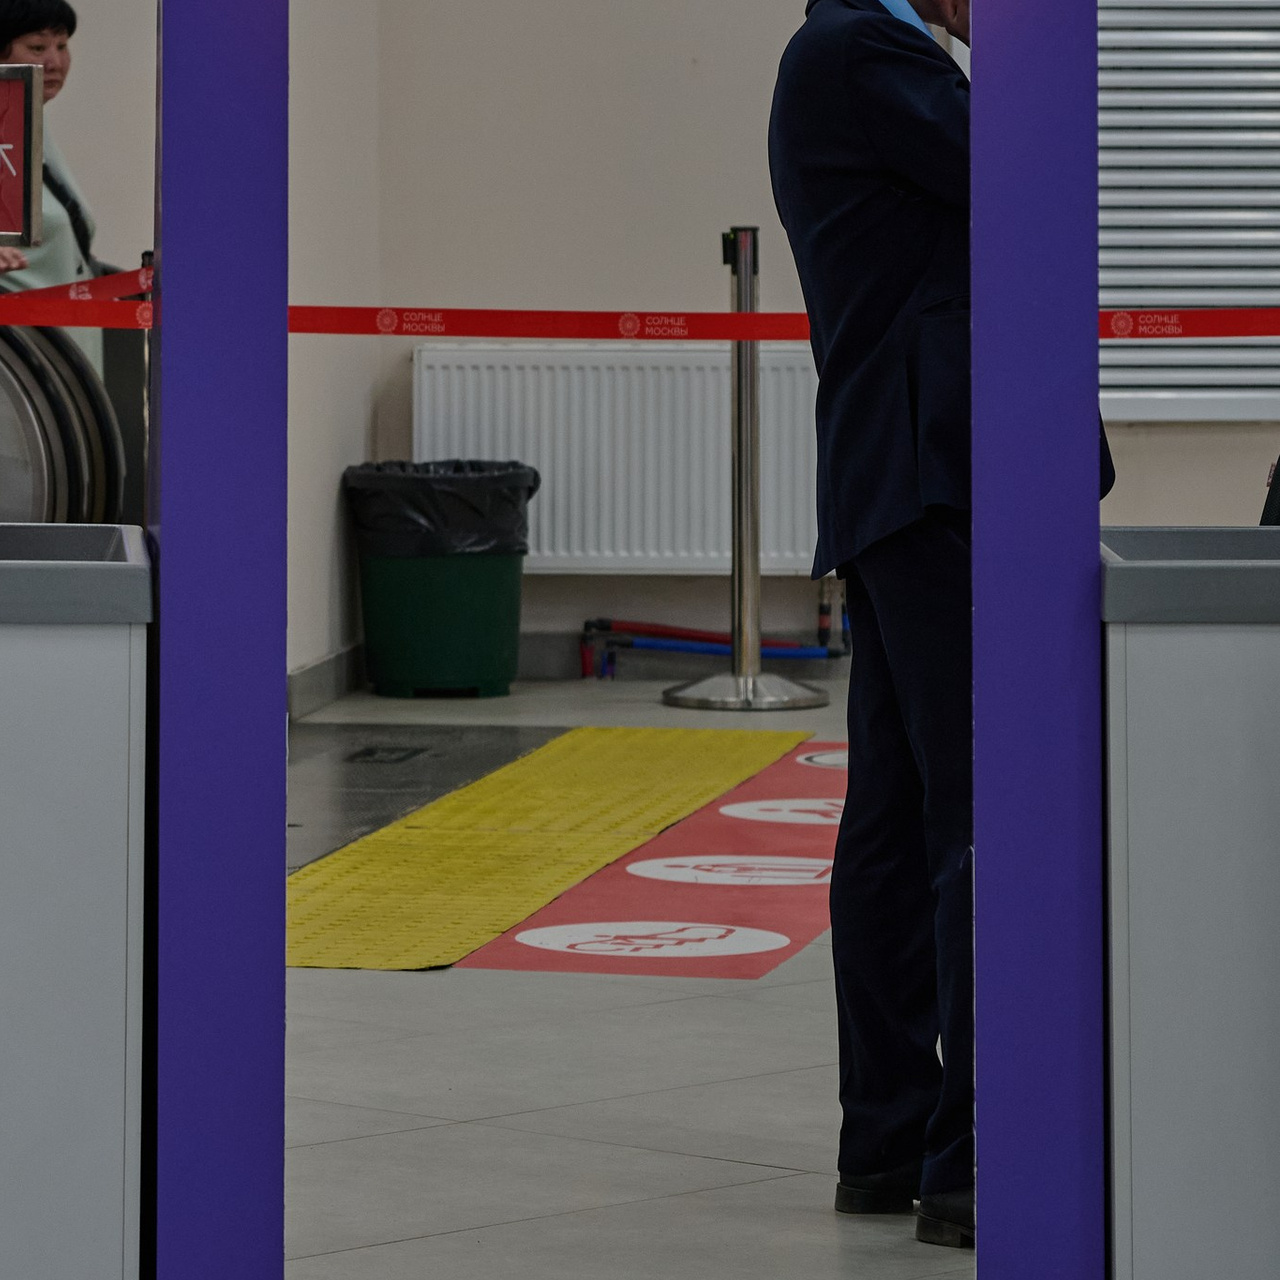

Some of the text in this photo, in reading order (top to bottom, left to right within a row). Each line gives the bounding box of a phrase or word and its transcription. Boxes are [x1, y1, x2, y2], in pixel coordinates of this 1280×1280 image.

[403, 312, 443, 322] СОЛНЦЕ
[645, 316, 686, 325] СОЛНЦЕ
[1139, 314, 1179, 324] СОЛНЦЕ
[403, 323, 446, 332] МОСКВЫ
[645, 327, 688, 336] МОСКВЫ
[1138, 325, 1183, 334] МОСКВЫ
